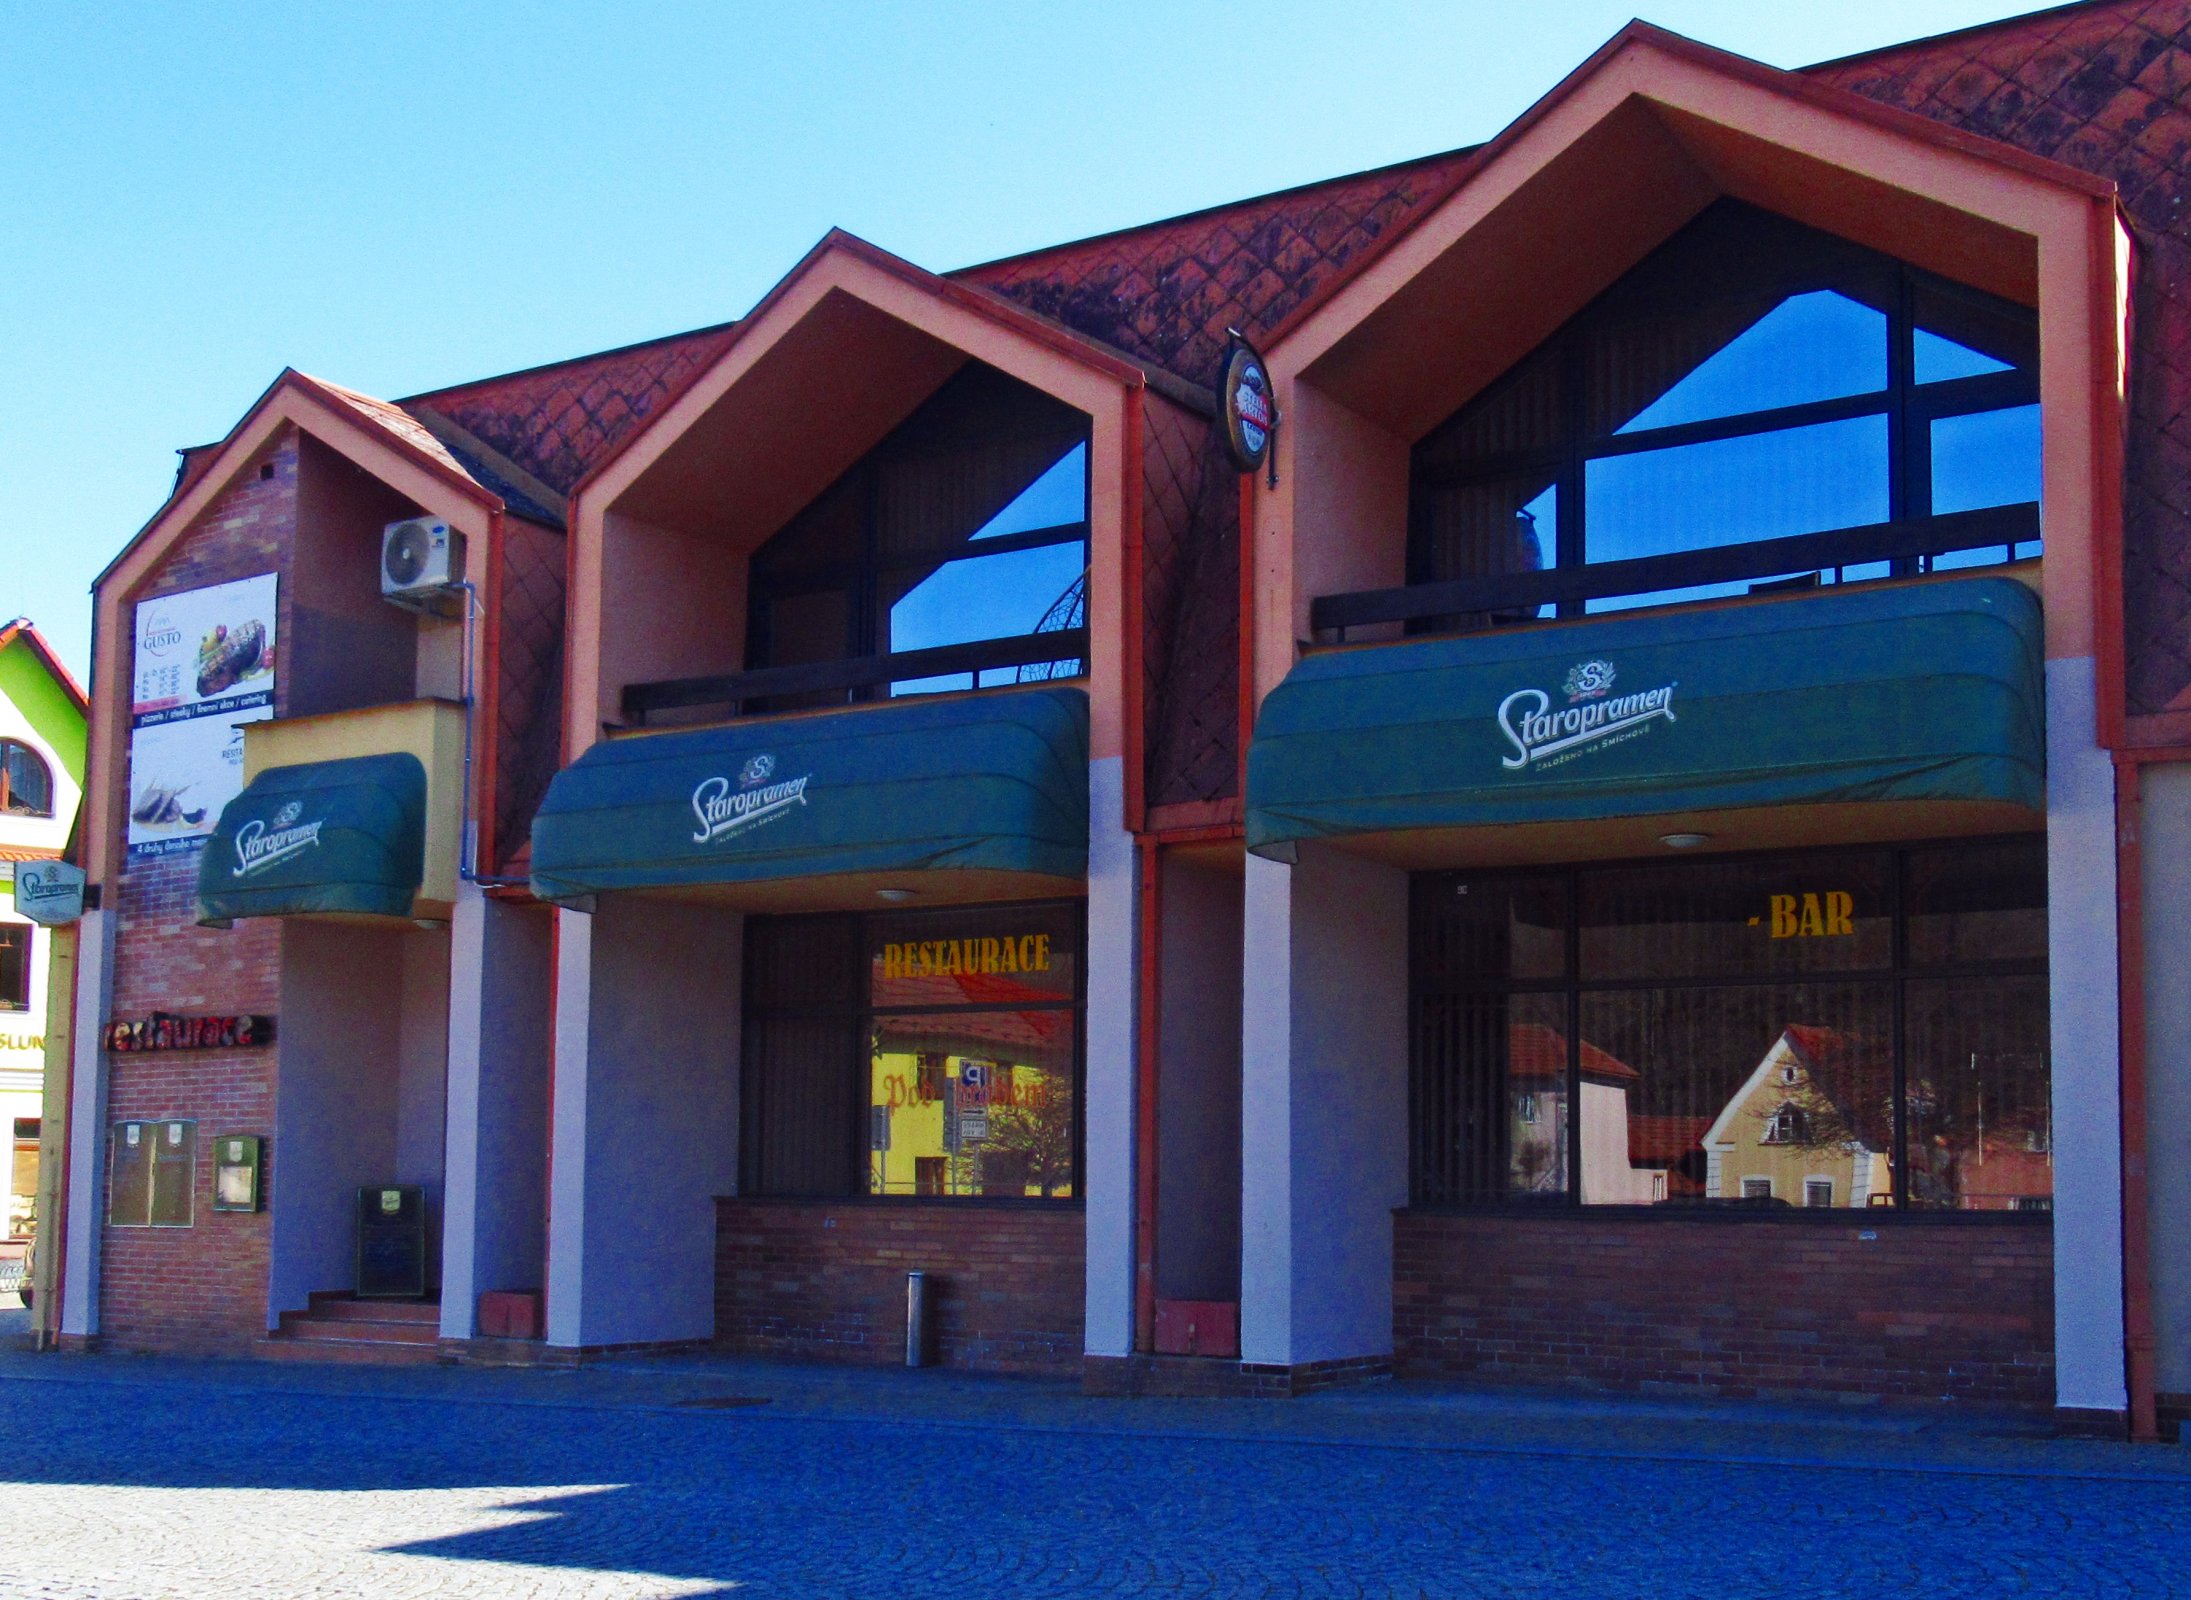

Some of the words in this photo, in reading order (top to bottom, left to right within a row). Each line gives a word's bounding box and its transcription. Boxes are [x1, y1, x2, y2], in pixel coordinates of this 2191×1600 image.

[144, 631, 181, 650] GUSTO
[241, 694, 267, 706] catering
[1498, 689, 1677, 770] Staropramen
[692, 776, 808, 844] Staropramen
[232, 819, 324, 878] Staropramen
[22, 872, 80, 902] Staropramen
[1770, 891, 1854, 938] BAR
[883, 934, 1049, 980] RESTAURACE
[103, 1013, 253, 1051] restaurace
[883, 1072, 936, 1116] Pod
[954, 1075, 1047, 1110] hradem
